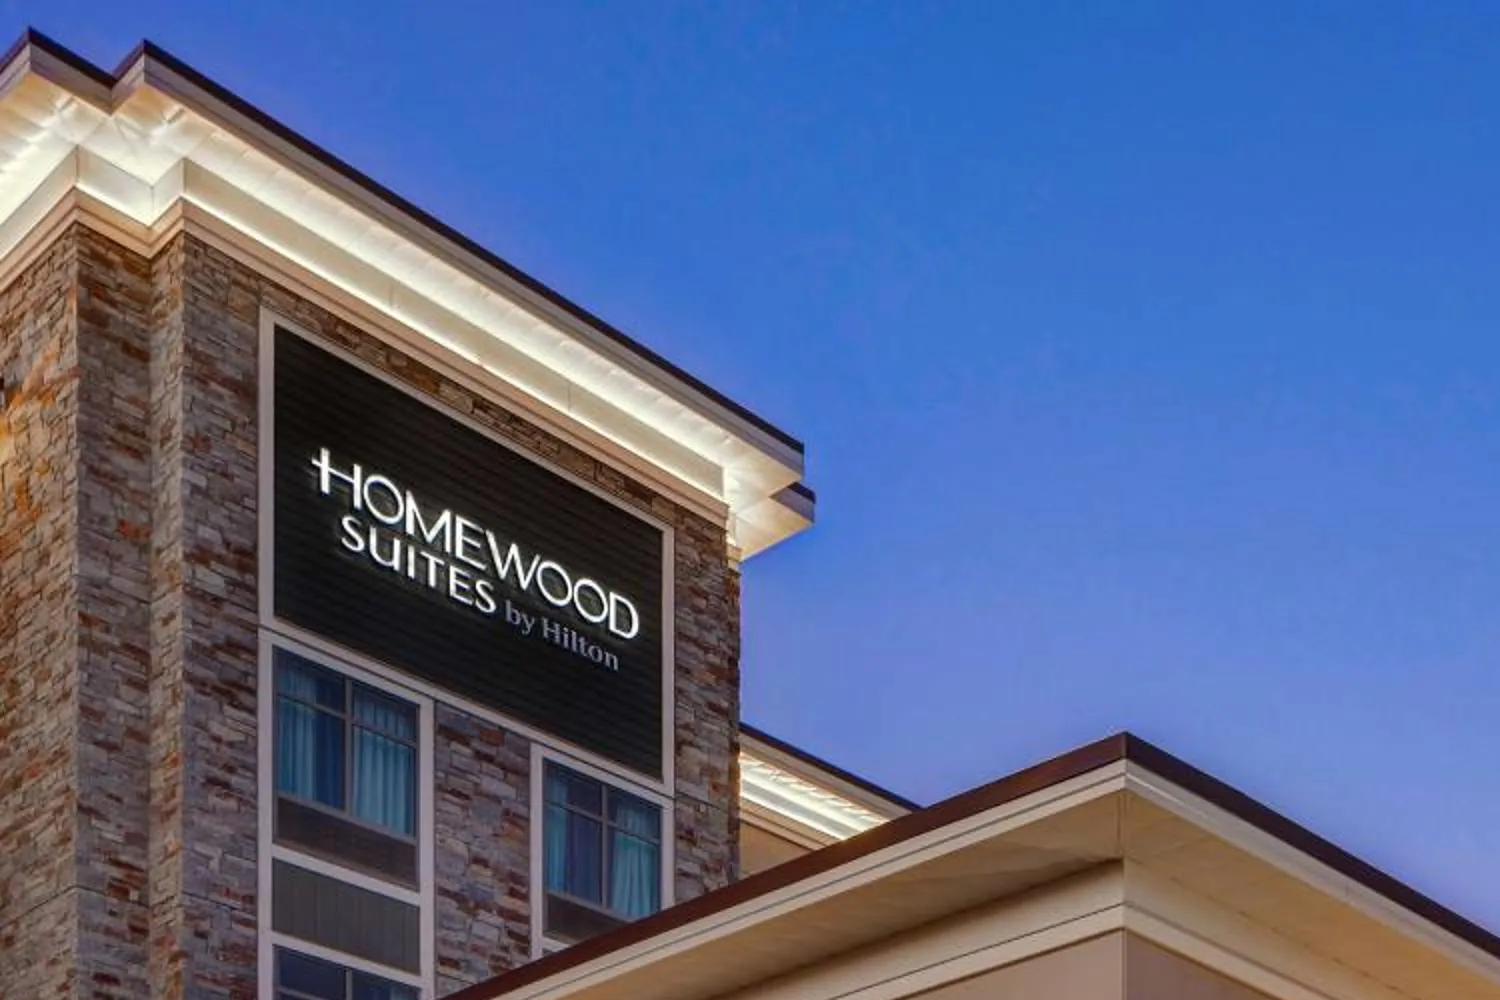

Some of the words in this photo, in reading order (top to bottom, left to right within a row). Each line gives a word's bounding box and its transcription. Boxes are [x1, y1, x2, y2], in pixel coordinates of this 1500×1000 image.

[311, 447, 639, 640] HOMEWOOD
[341, 515, 497, 614] SUITES
[505, 600, 534, 635] by
[542, 617, 619, 672] Hilton
